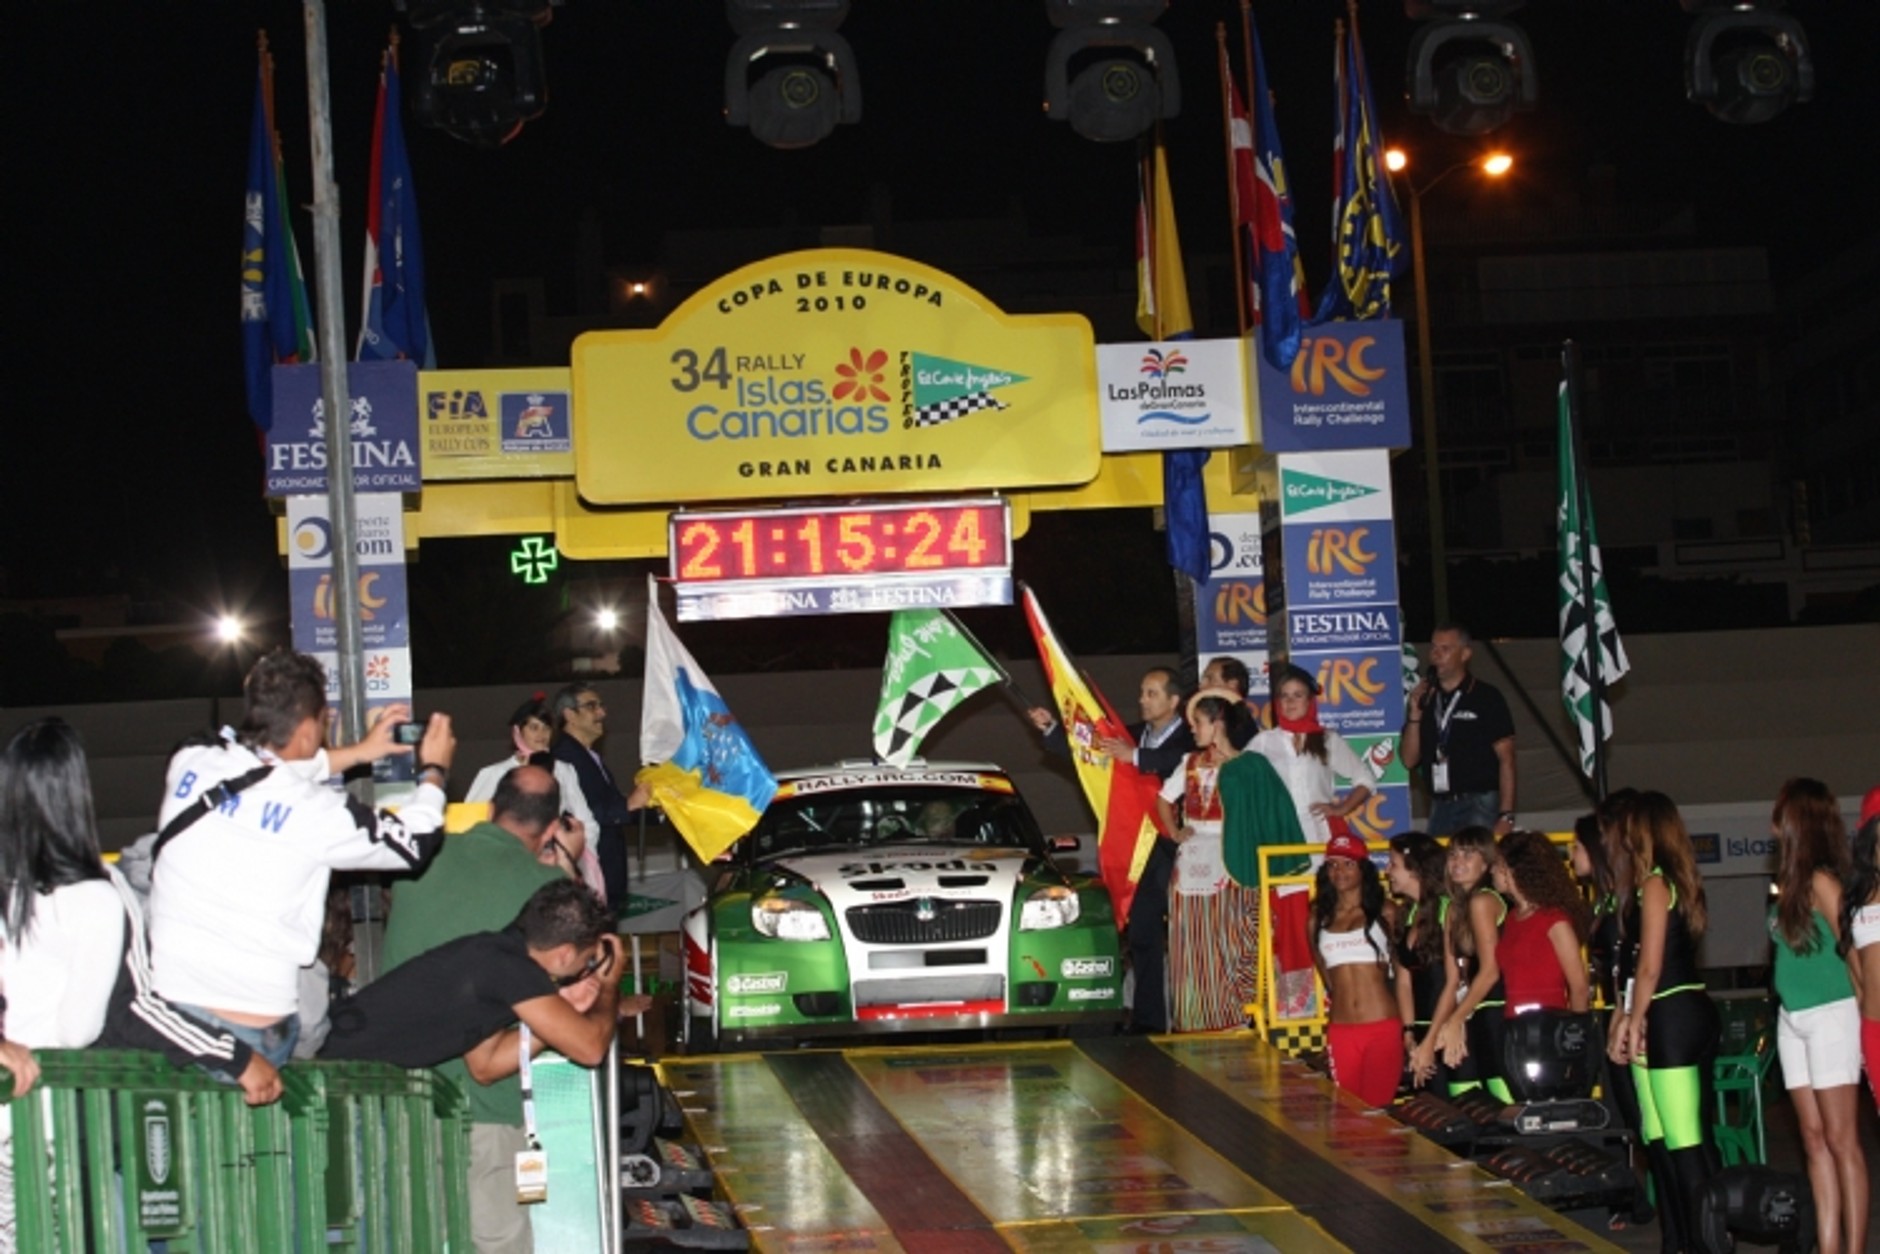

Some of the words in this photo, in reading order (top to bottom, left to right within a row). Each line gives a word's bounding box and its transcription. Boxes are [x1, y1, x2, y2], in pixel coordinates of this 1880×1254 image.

[717, 279, 783, 314] COPA
[796, 271, 828, 289] DE
[842, 271, 945, 307] EUROPA
[797, 295, 867, 312] 2010
[669, 346, 733, 393] 34
[736, 353, 806, 372] RALLY
[1292, 400, 1385, 414] Intercontinental
[686, 404, 890, 441] Canarias
[1293, 414, 1323, 427] Rally
[1325, 412, 1385, 427] Challenge
[428, 423, 489, 435] EUROPEAN
[429, 438, 463, 452] RALLY
[464, 437, 490, 450] CUPS
[271, 440, 416, 471] FESINA
[738, 459, 811, 477] GRAN
[826, 453, 942, 474] CANARIA
[371, 473, 417, 487] OFICIAL
[680, 508, 988, 579] 21:15:24
[1308, 577, 1377, 589] Intercontinental
[870, 585, 954, 605] FESTINA
[1308, 588, 1331, 600] Rally
[1333, 587, 1378, 599] Challenge
[1292, 611, 1391, 634] FESTINA
[796, 772, 978, 792] RALLY-IRC.COM
[1075, 959, 1110, 976] Castrol
